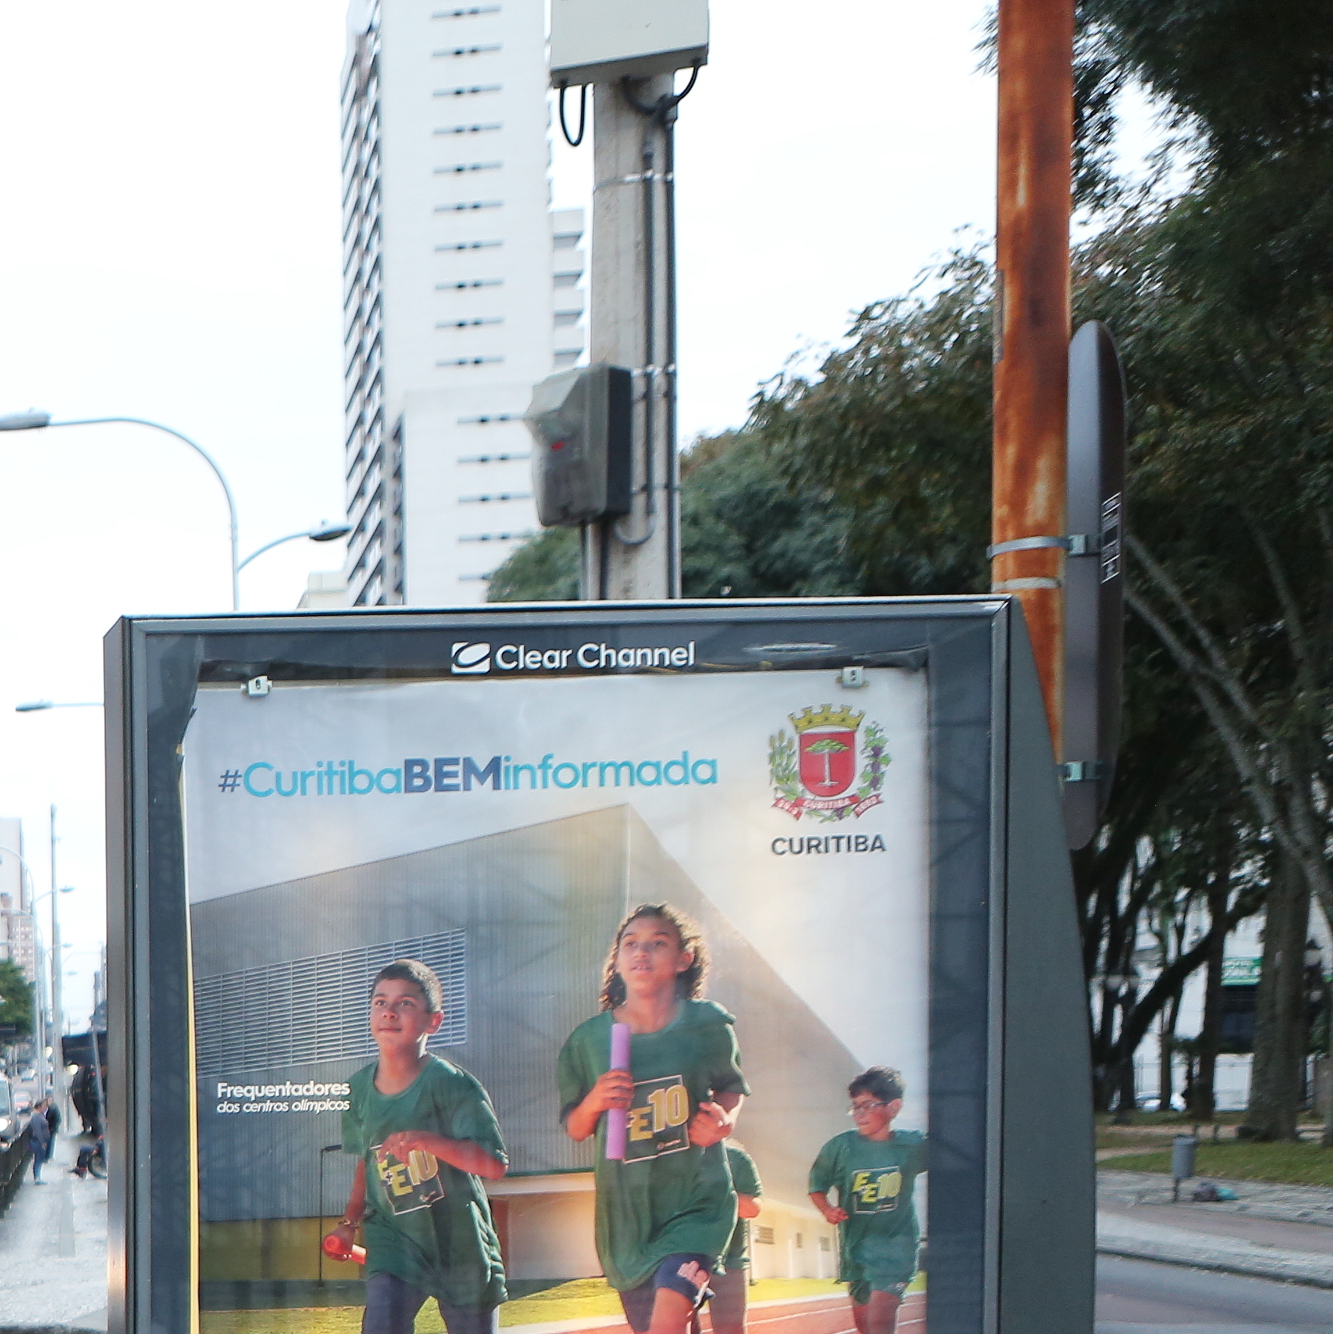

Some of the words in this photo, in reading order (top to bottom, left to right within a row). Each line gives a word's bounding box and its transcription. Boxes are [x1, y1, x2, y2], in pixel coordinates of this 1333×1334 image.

[495, 643, 573, 671] Clear
[576, 640, 696, 669] Channel
[218, 749, 719, 798] #CuritibaBEMinformada
[771, 833, 887, 855] CURITIBA
[217, 1080, 352, 1102] Frequentadores
[216, 1101, 241, 1114] dos
[242, 1099, 290, 1114] centros
[291, 1098, 351, 1116] olímpicos
